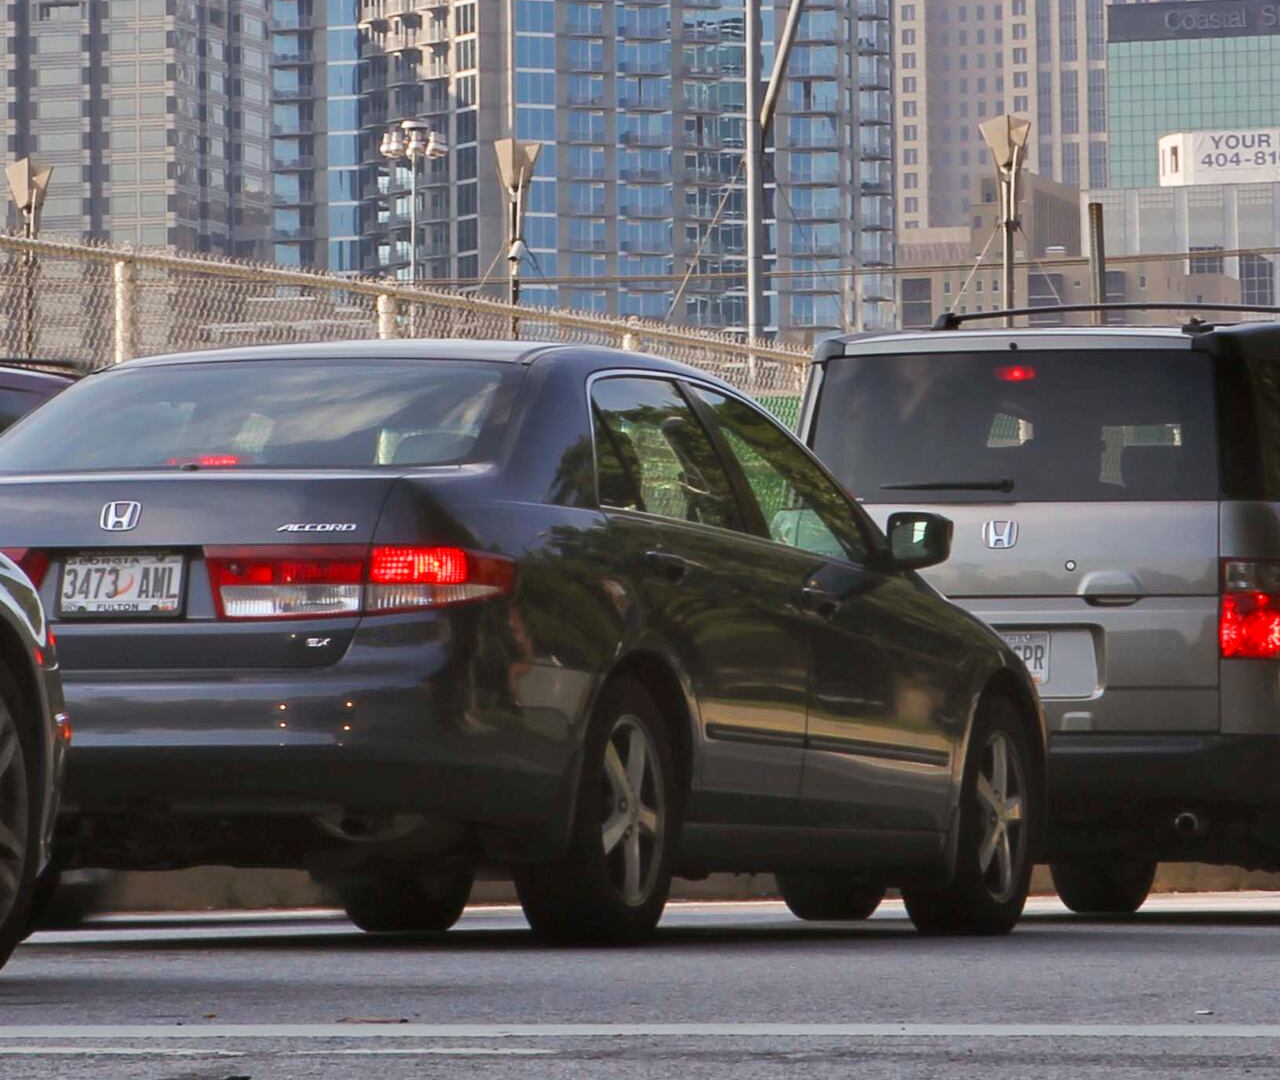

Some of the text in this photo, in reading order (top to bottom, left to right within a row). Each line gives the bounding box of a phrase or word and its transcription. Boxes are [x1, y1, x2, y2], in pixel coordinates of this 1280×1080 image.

[1164, 8, 1247, 32] Coastal
[1210, 133, 1271, 150] YOUR
[276, 522, 358, 533] ACCORD
[62, 566, 178, 600] 3473 AML
[96, 603, 139, 612] FULTON
[305, 637, 332, 648] EX
